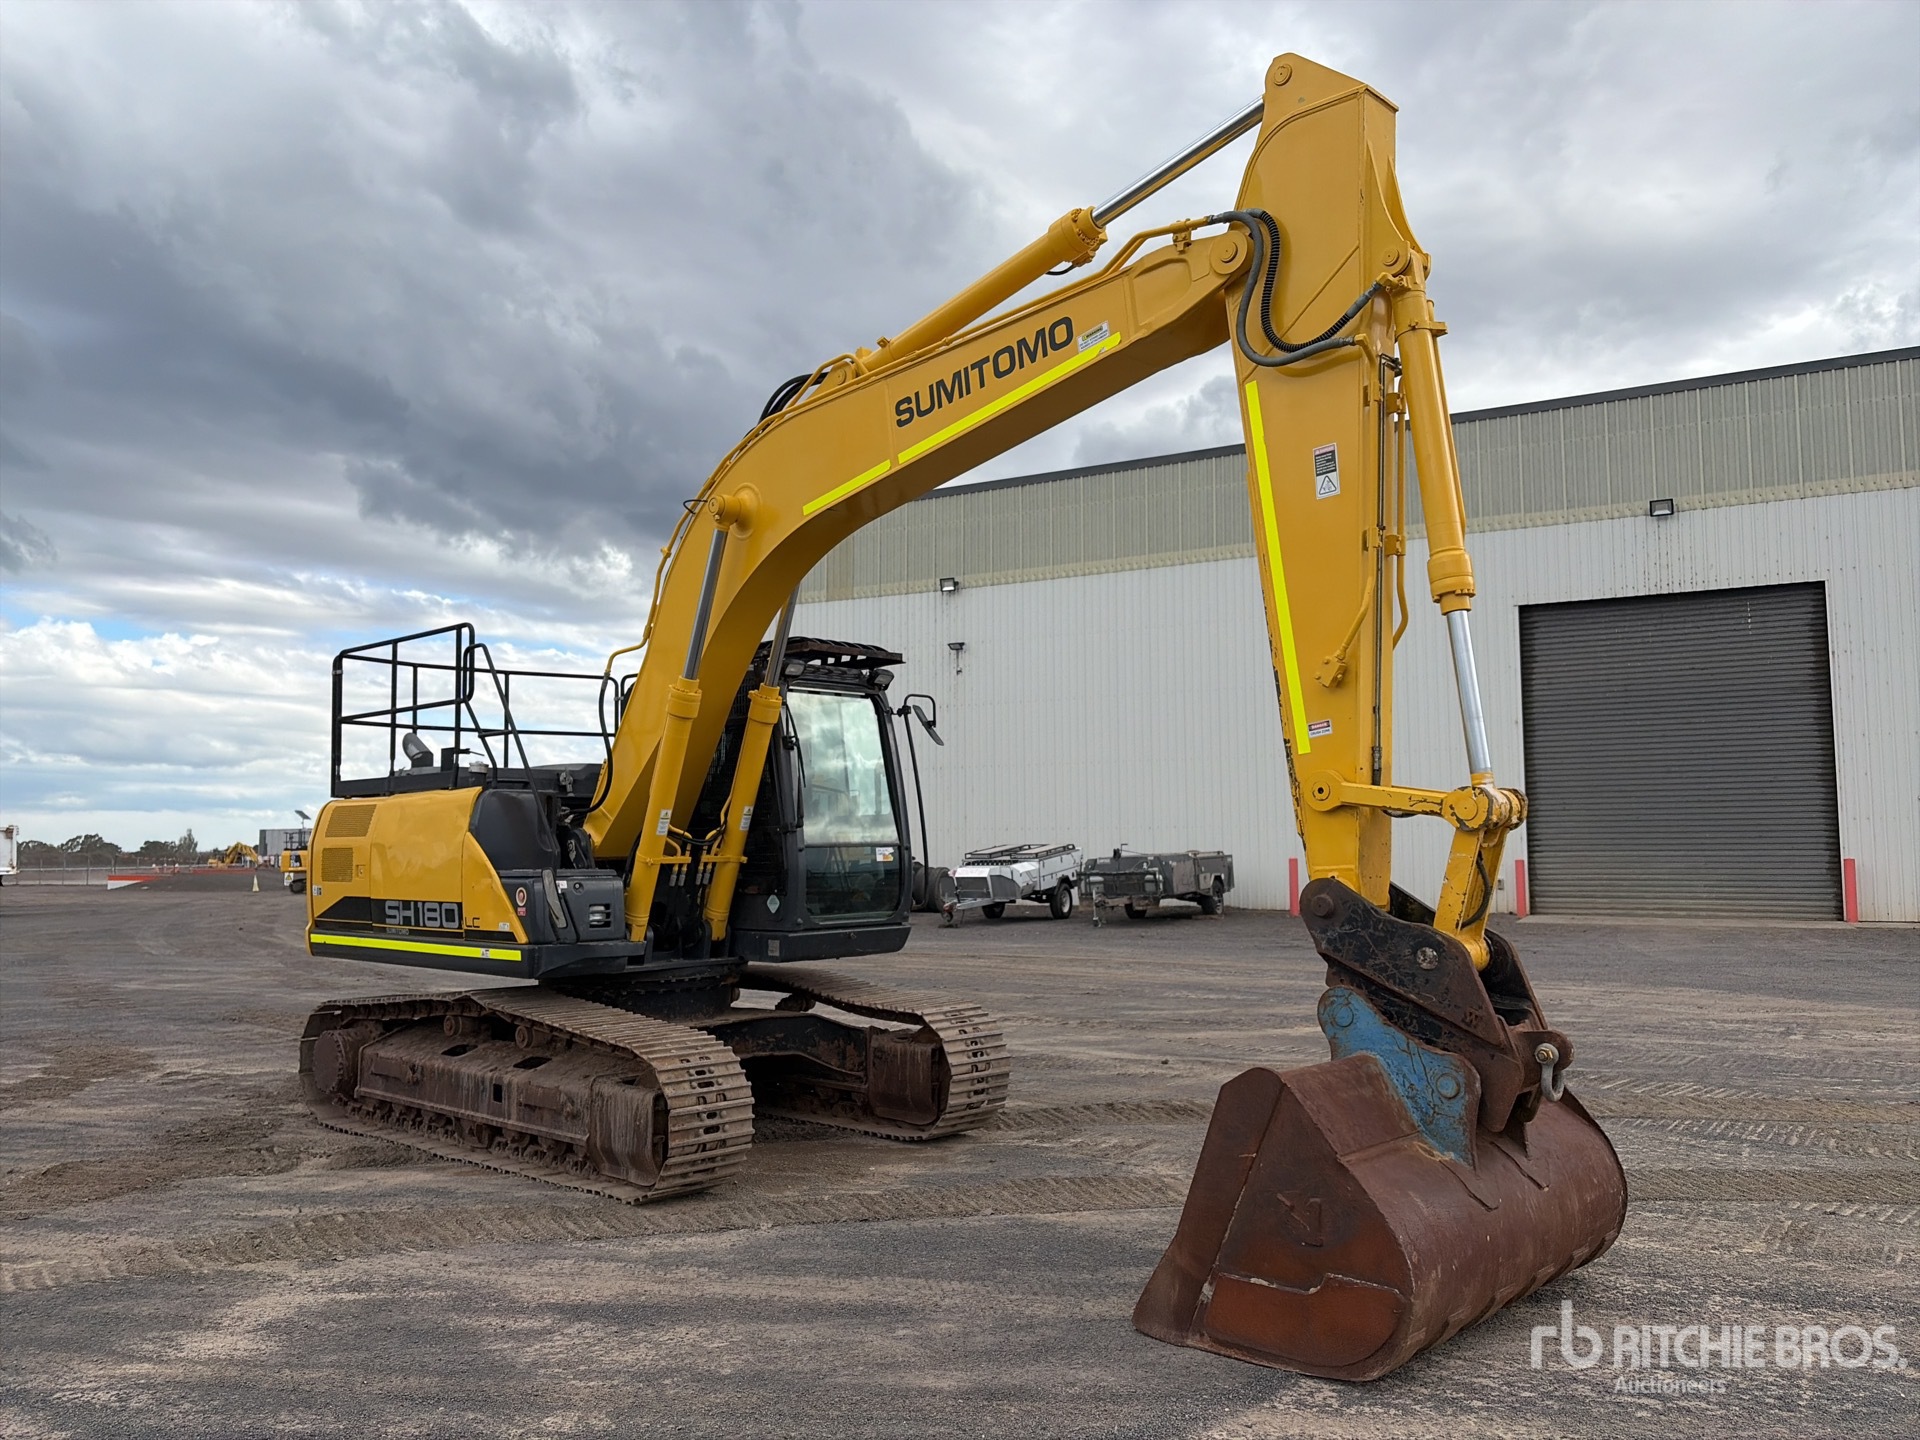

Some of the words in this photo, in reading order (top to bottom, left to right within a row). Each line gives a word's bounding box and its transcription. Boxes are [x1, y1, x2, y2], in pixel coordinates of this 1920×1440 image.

[895, 316, 1073, 427] SUMITOMO
[385, 900, 459, 929] SH180
[465, 916, 480, 928] LC
